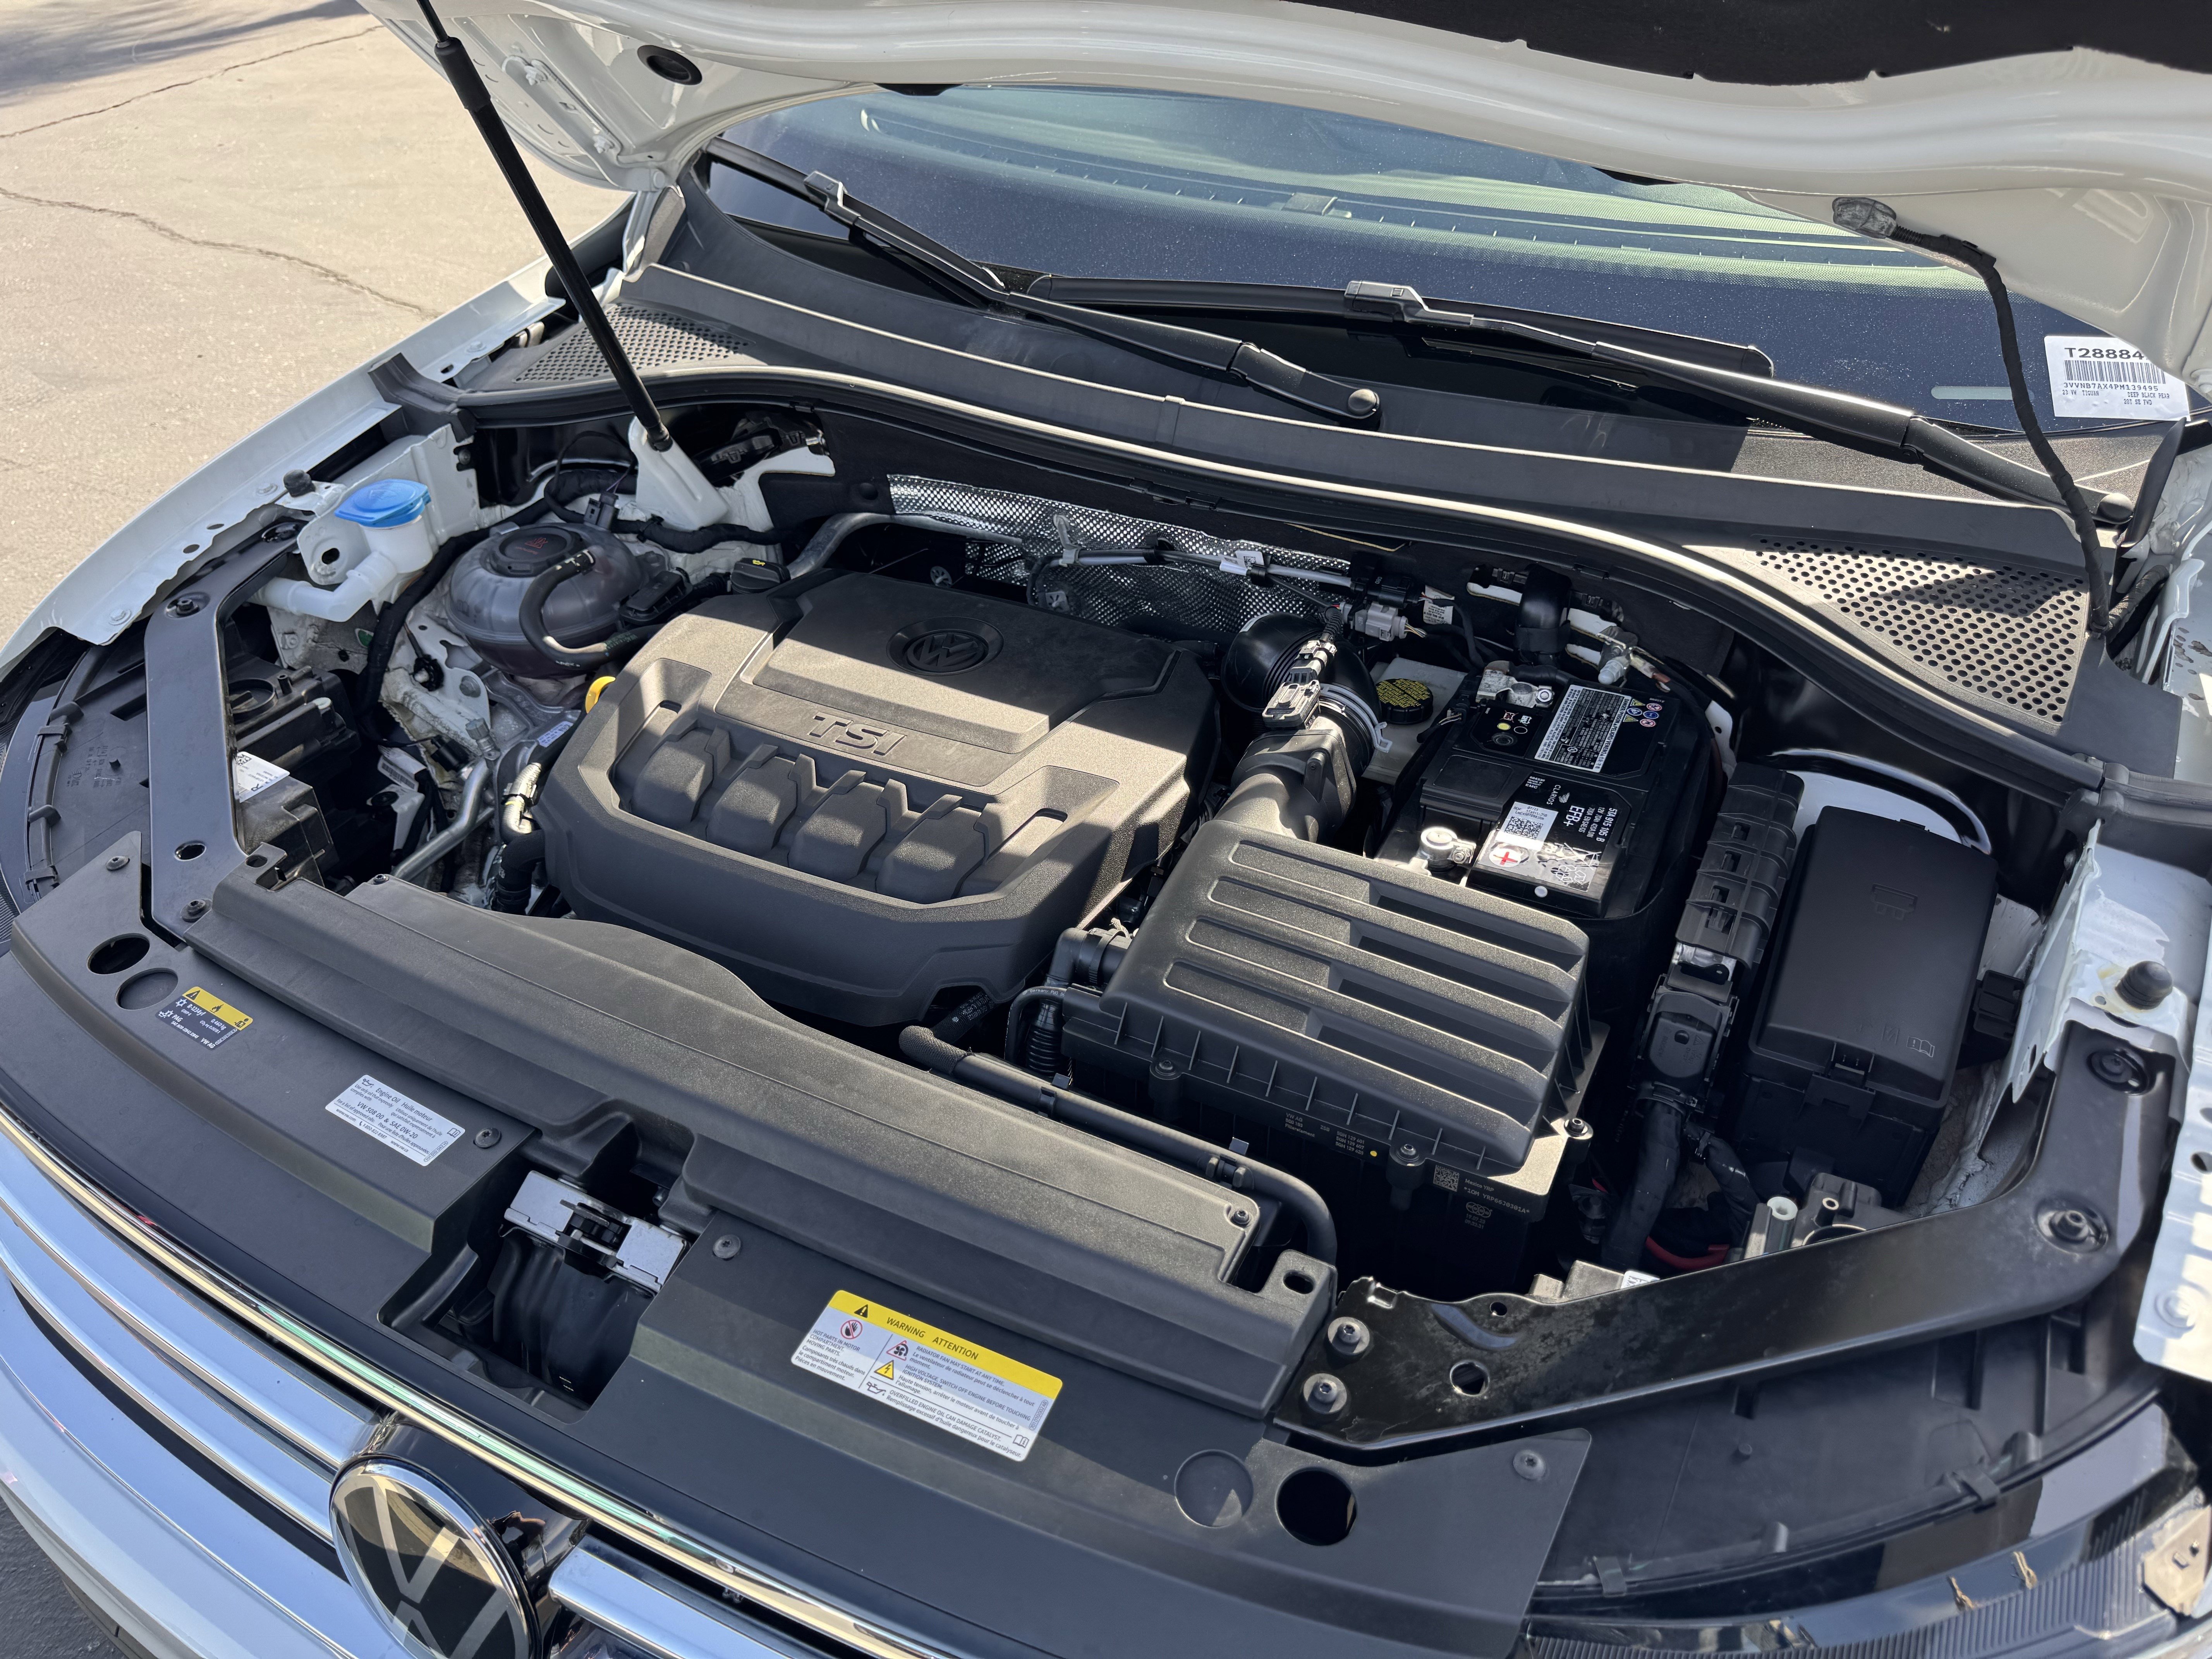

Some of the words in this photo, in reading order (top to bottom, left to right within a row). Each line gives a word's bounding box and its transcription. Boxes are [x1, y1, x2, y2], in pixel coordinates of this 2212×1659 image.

[2064, 347, 2148, 361] T28884
[2063, 382, 2158, 391] 3VVNB7AX4PM139495
[807, 711, 908, 757] TSI
[1546, 785, 1561, 805] CLARIOS
[1563, 805, 1585, 826] EFB+
[1603, 817, 1614, 827] 915
[1607, 808, 1618, 817] 5TA
[1599, 827, 1609, 836] 105
[171, 1014, 184, 1022] PAG
[373, 1087, 393, 1100] Engine
[400, 1101, 416, 1112] Huile
[413, 1109, 434, 1121] moteur
[356, 1101, 368, 1110] VW
[365, 1107, 378, 1115] 508
[389, 1120, 402, 1129] SAE
[399, 1126, 419, 1139] 0W-20
[1465, 1178, 1482, 1188] Mexico
[806, 1338, 826, 1350] MOVING
[824, 1346, 842, 1357] PARTS.
[809, 1333, 845, 1352] COMPARTMENT.
[823, 1333, 838, 1342] PARTS
[843, 1341, 860, 1352] MOTOR
[885, 1317, 927, 1338] WARNING
[931, 1336, 980, 1360] ATTENTION
[795, 1355, 811, 1365] Pièces
[816, 1365, 846, 1381] mouvement.
[801, 1345, 830, 1360] Composants
[838, 1360, 855, 1370] chauds
[854, 1367, 866, 1375] dans
[803, 1352, 837, 1370] compartiment
[836, 1367, 855, 1378] moteur.
[909, 1357, 932, 1369] moment.
[915, 1345, 940, 1359] RADIATOR
[939, 1355, 950, 1363] FAN
[960, 1364, 975, 1374] START
[992, 1377, 1006, 1386] TIME.
[894, 1379, 922, 1395] l'allumage.
[902, 1369, 924, 1381] IGNITION
[923, 1377, 944, 1389] SYSTEM.
[918, 1354, 946, 1369] ventilateur
[951, 1368, 975, 1381] radiateur
[973, 1377, 987, 1386] peut
[992, 1385, 1020, 1400] déclencher
[1023, 1398, 1035, 1407] tout
[898, 1375, 914, 1385] Haute
[913, 1381, 933, 1393] tension,
[932, 1389, 951, 1400] arrêter
[955, 1400, 974, 1410] moteur
[973, 1408, 989, 1417] avant
[995, 1416, 1016, 1429] toucher
[905, 1364, 918, 1372] HIGH
[939, 1378, 958, 1389] SWITCH
[967, 1390, 986, 1401] ENGINE
[986, 1398, 1006, 1410] BEFORE
[1005, 1406, 1032, 1421] TOUCHING
[889, 1389, 919, 1405] OVERFILLED
[917, 1401, 937, 1413] ENGINE
[945, 1413, 957, 1422] CAN
[956, 1418, 978, 1431] DAMAGE
[976, 1427, 1003, 1442] CATALYST.
[885, 1395, 917, 1413] Remplissage
[915, 1407, 936, 1420] excessif
[934, 1416, 952, 1427] d'huile
[951, 1423, 978, 1439] dangereux
[977, 1435, 990, 1444] pour
[994, 1442, 1023, 1459] catalyseur.
